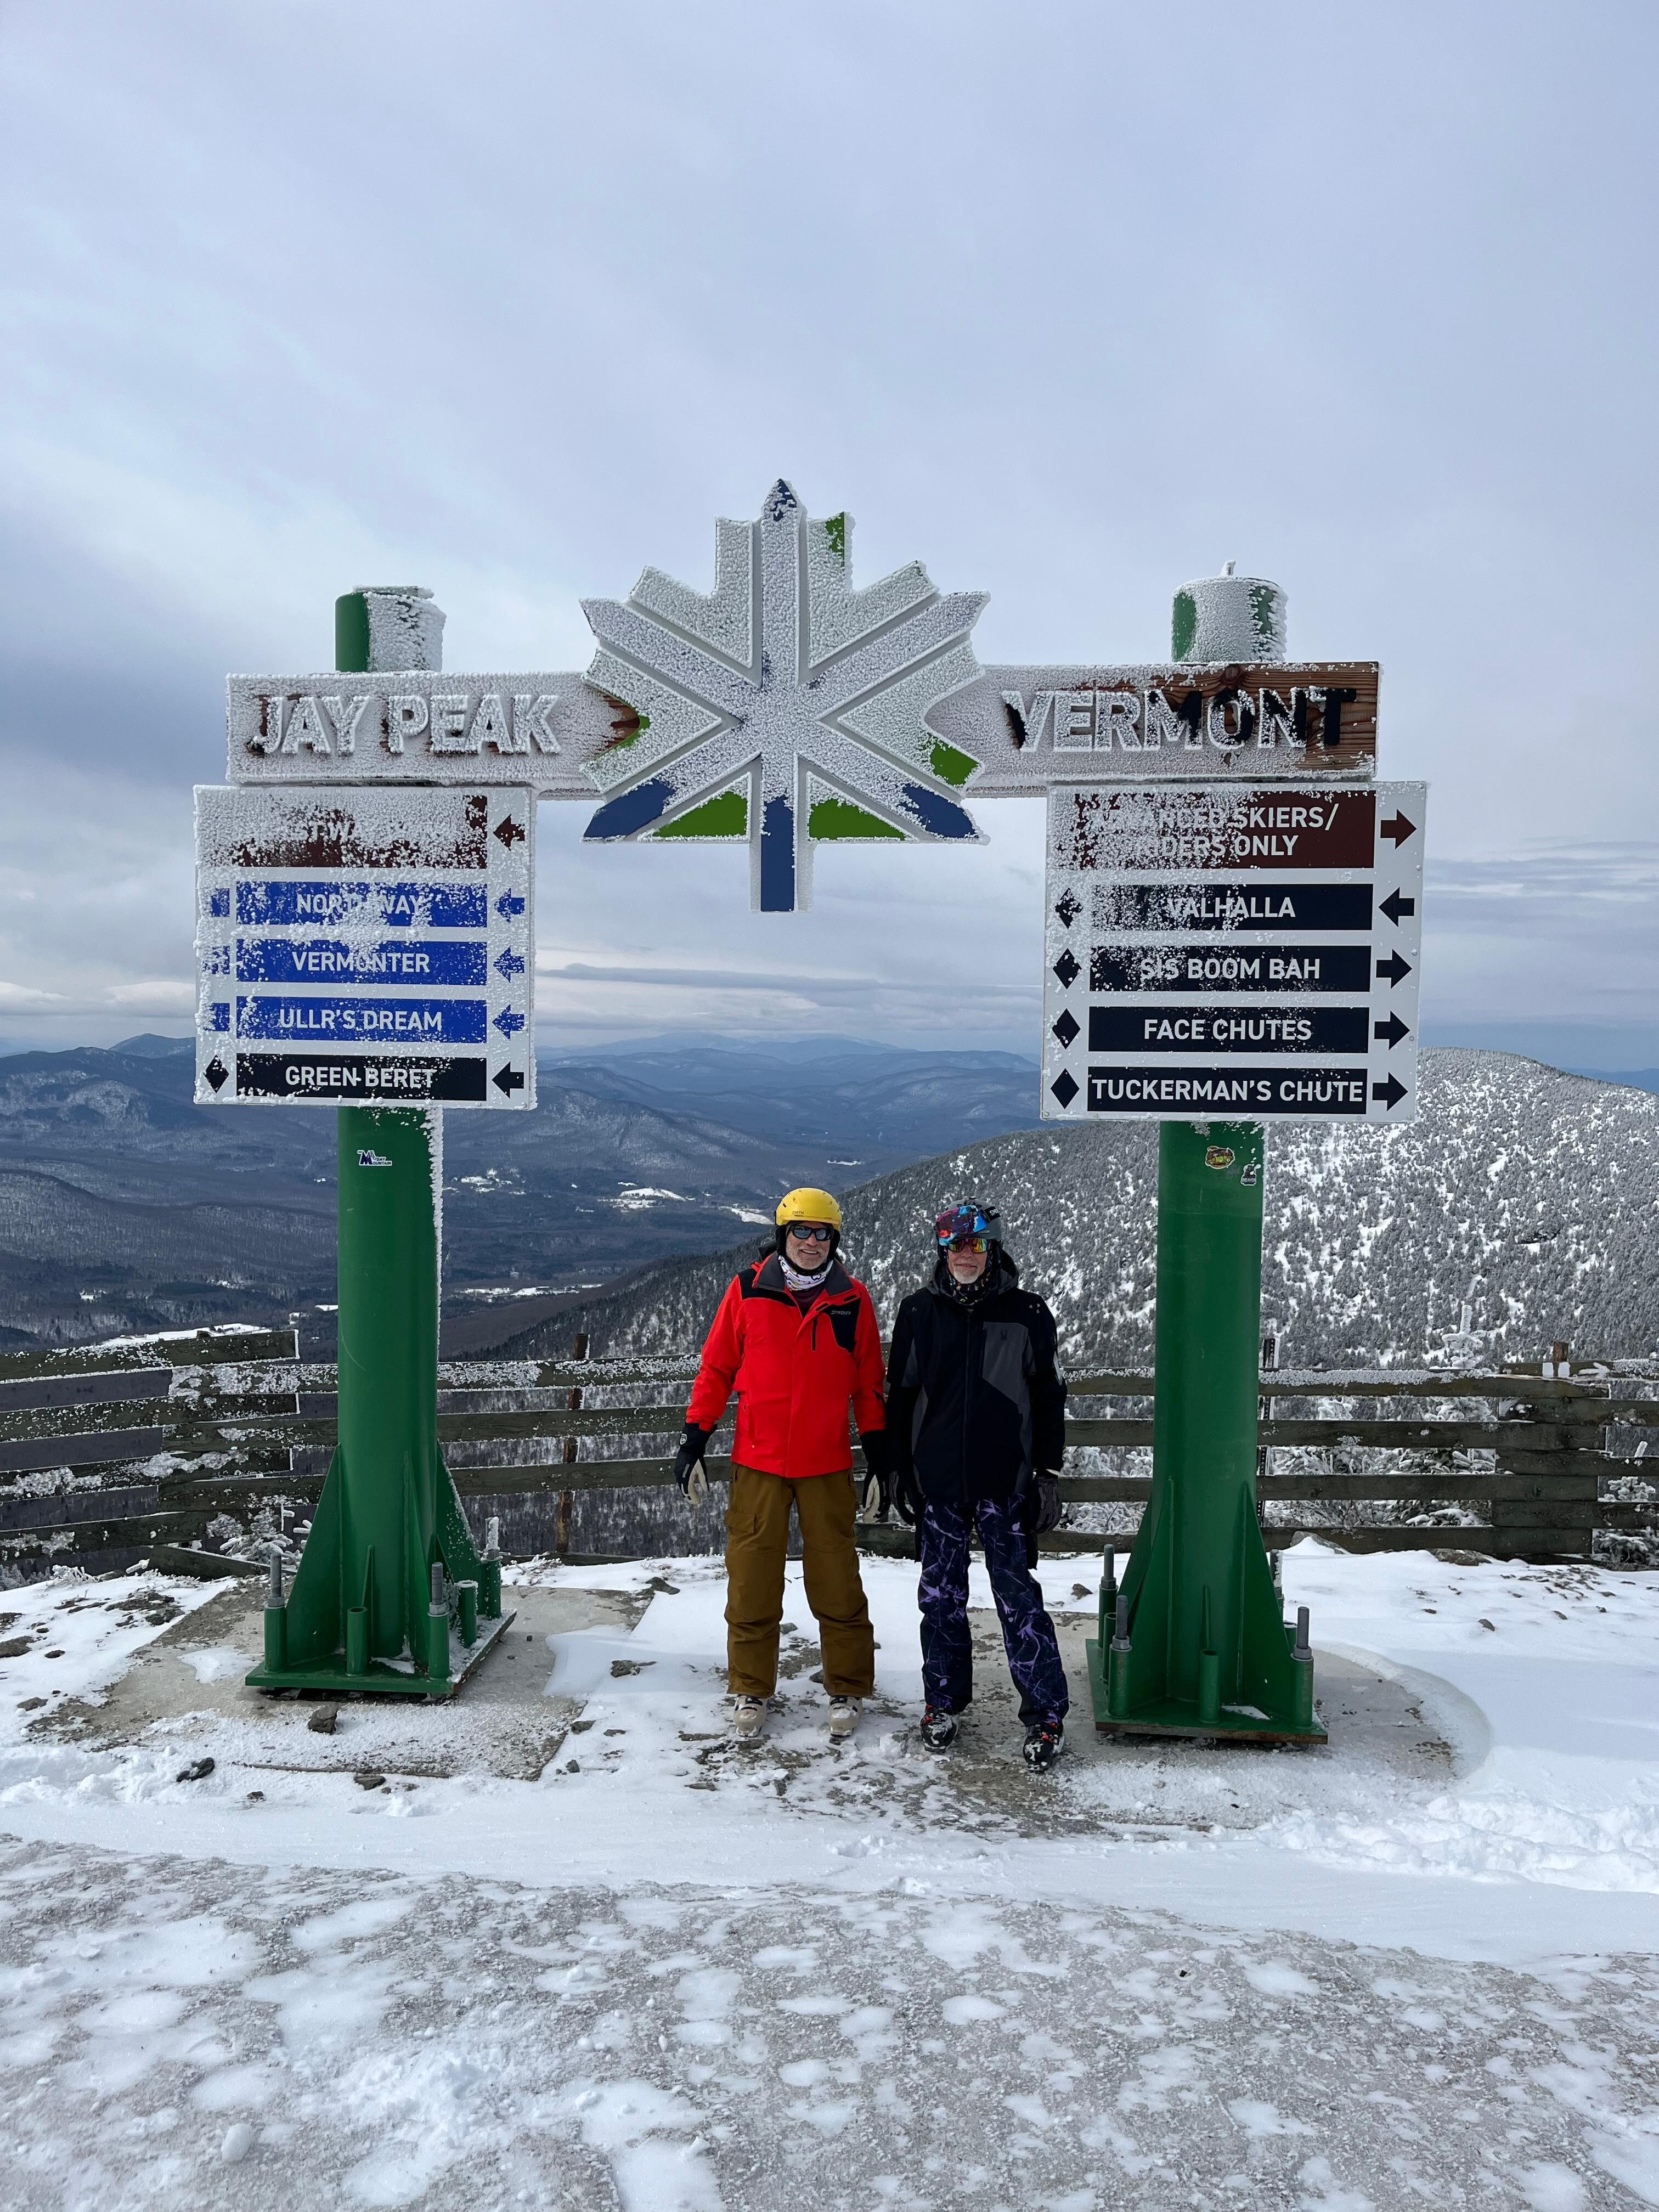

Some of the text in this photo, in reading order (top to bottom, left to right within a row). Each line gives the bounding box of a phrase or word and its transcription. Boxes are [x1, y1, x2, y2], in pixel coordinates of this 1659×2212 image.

[247, 695, 562, 755] JAY PEAK
[1002, 685, 1357, 752] VERMONT
[1238, 804, 1339, 831] SKIERS/
[1234, 834, 1299, 856] ONLY
[1167, 896, 1296, 918] VALHALLA
[292, 951, 430, 973] VERMONTER
[1140, 958, 1321, 979] SIS BOOM BAH
[279, 1009, 442, 1031] ULLR'S DREAM
[1144, 1019, 1312, 1041] FACE CHUTES
[285, 1066, 437, 1089] GREEN BERET
[1092, 1079, 1363, 1103] TUCKERMAN'S CHUTE
